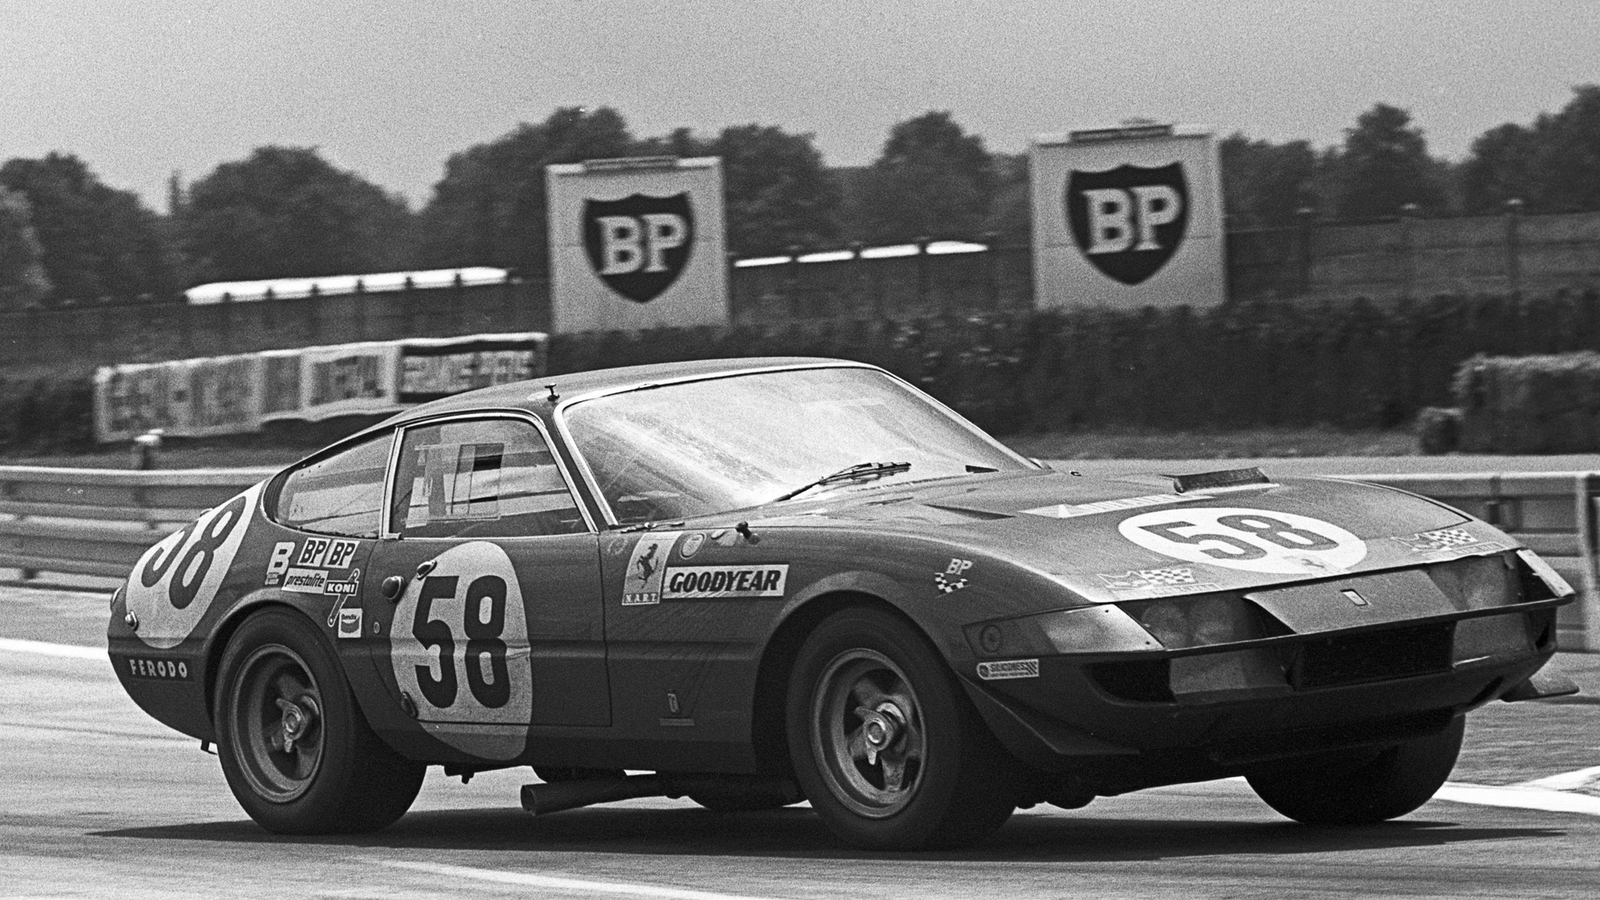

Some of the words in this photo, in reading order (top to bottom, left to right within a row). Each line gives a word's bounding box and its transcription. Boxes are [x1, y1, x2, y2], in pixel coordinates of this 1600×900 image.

[1079, 185, 1181, 254] BP
[595, 213, 687, 276] BP
[1138, 514, 1339, 560] 58
[300, 540, 327, 564] BP
[327, 541, 355, 566] BP
[946, 558, 973, 575] BP
[285, 573, 325, 588] prestolite
[327, 583, 354, 593] KONI
[669, 570, 781, 593] GOODYEAR
[412, 575, 510, 708] 58
[129, 659, 188, 678] FERODO
